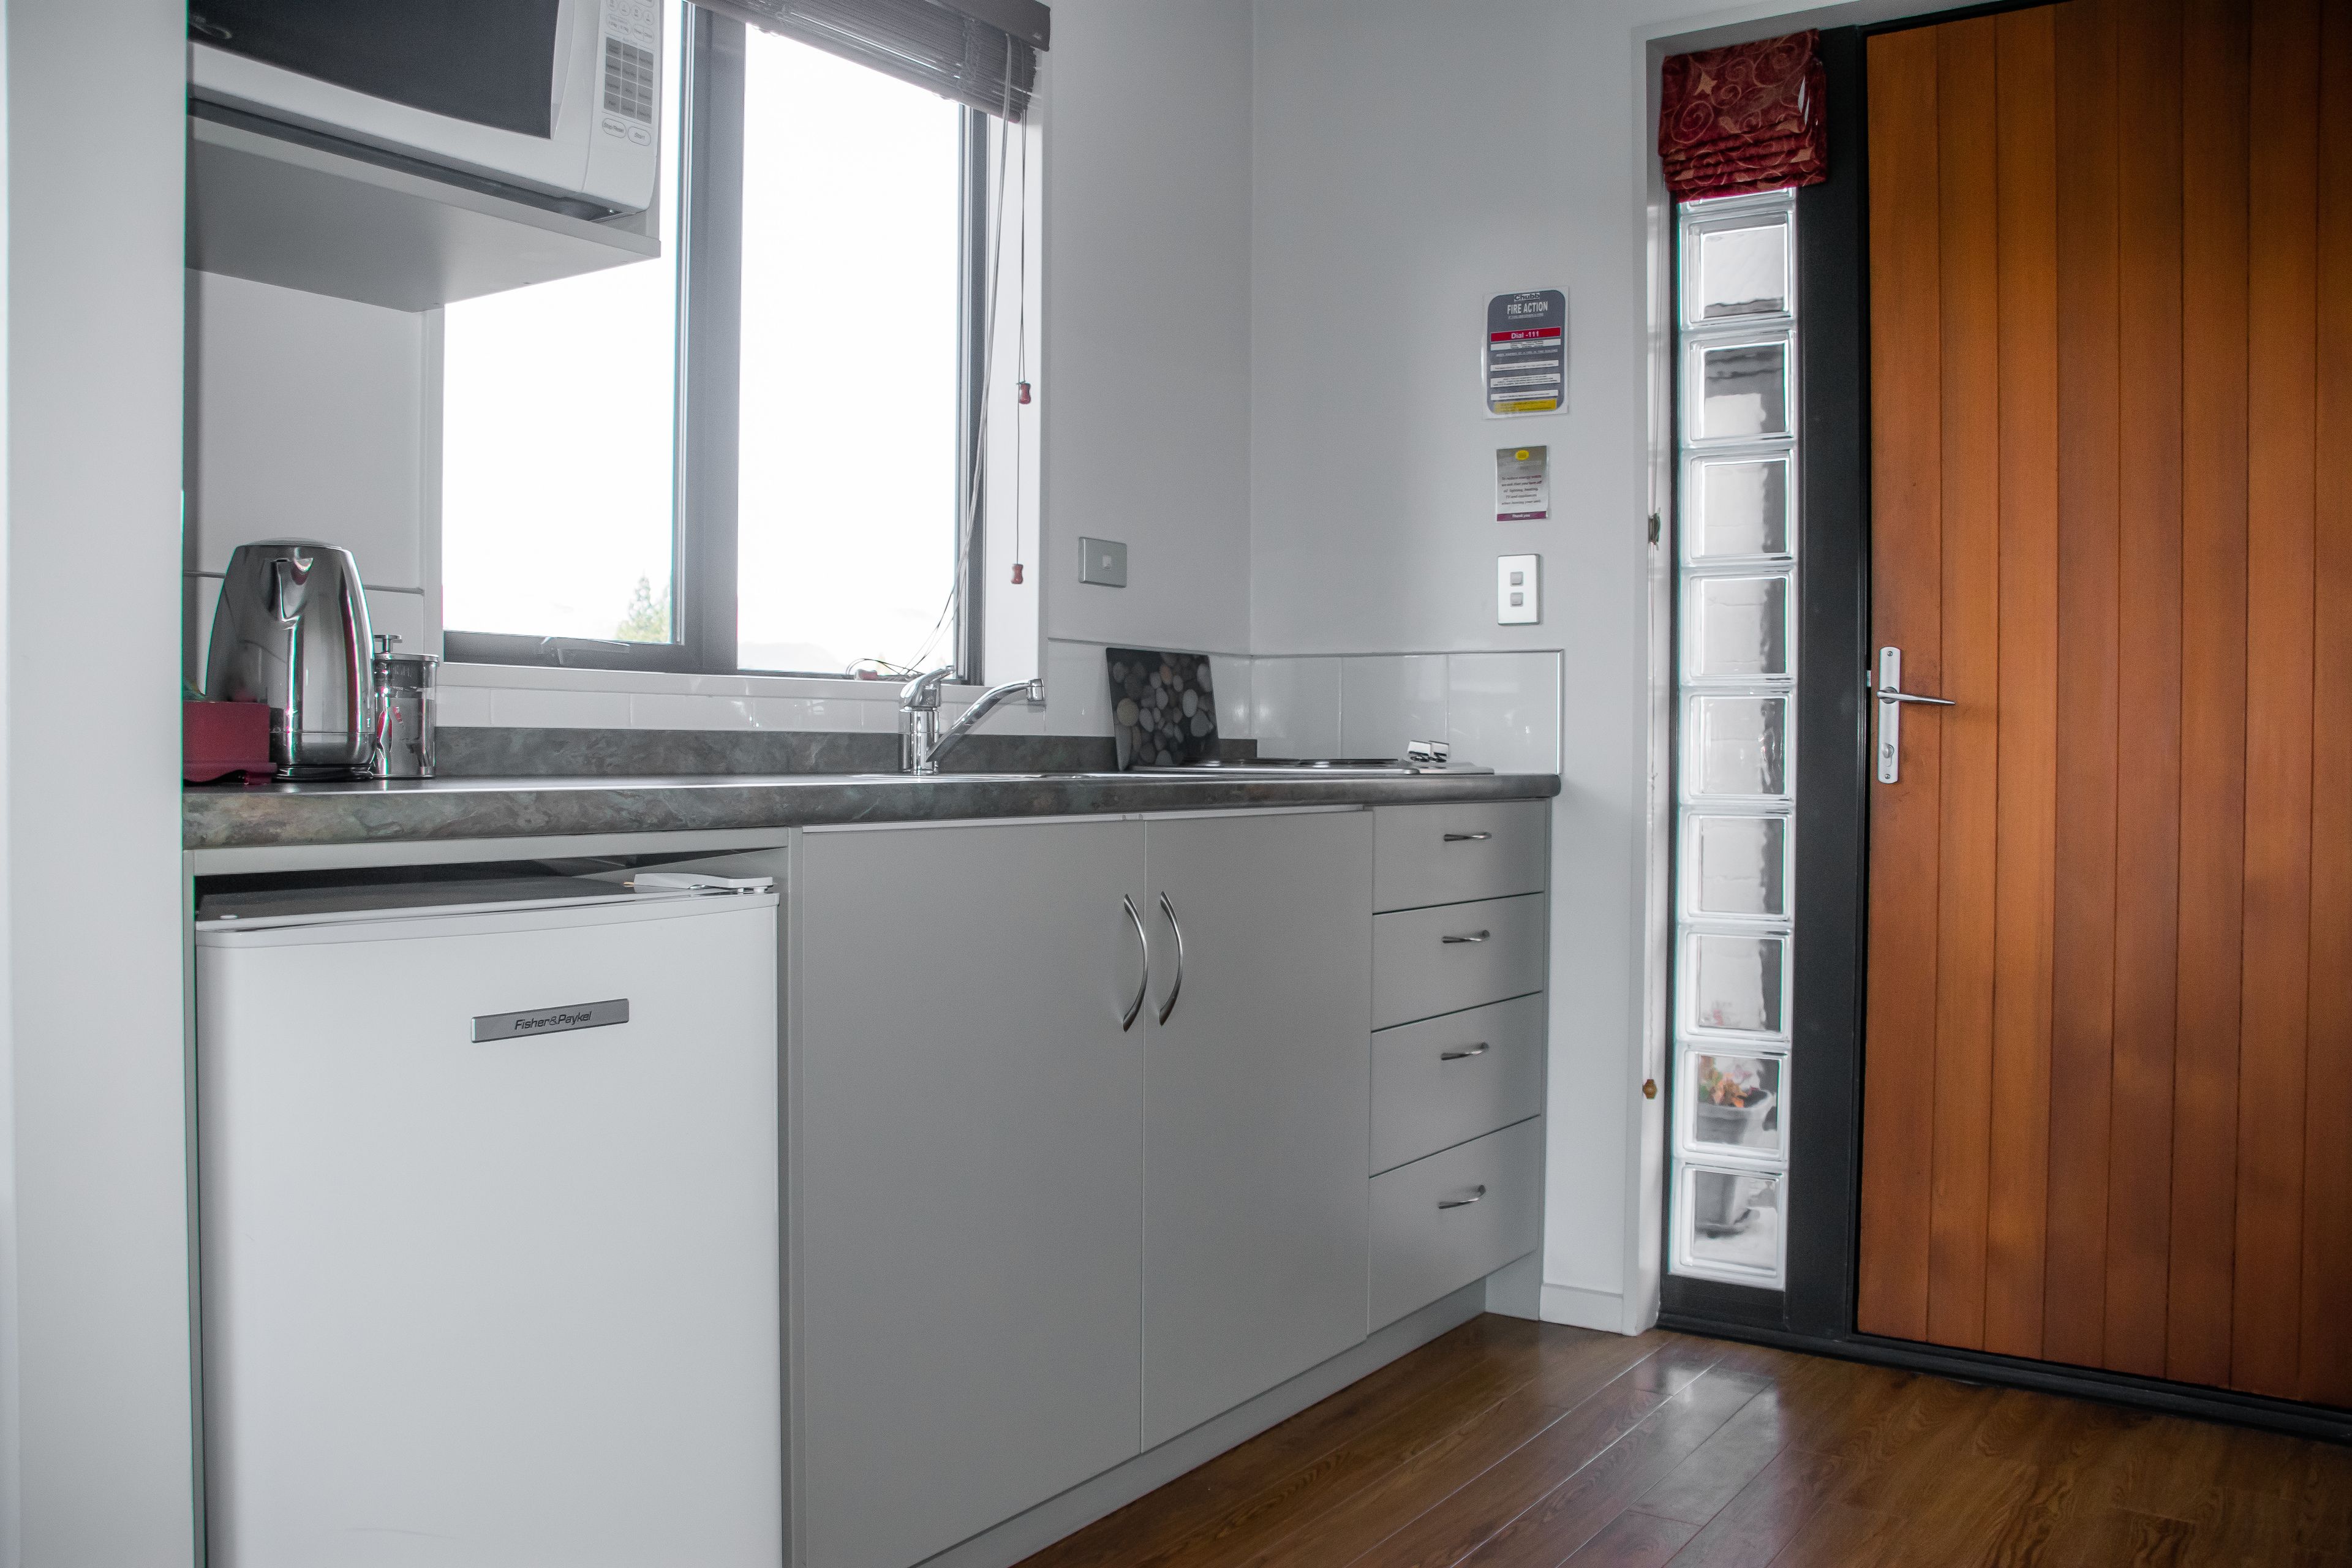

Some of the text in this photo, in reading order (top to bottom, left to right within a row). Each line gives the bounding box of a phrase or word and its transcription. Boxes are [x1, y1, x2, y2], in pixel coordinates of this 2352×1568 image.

[1507, 301, 1548, 315] FIRE ACTION
[514, 1011, 592, 1030] Fisher&Paykel
